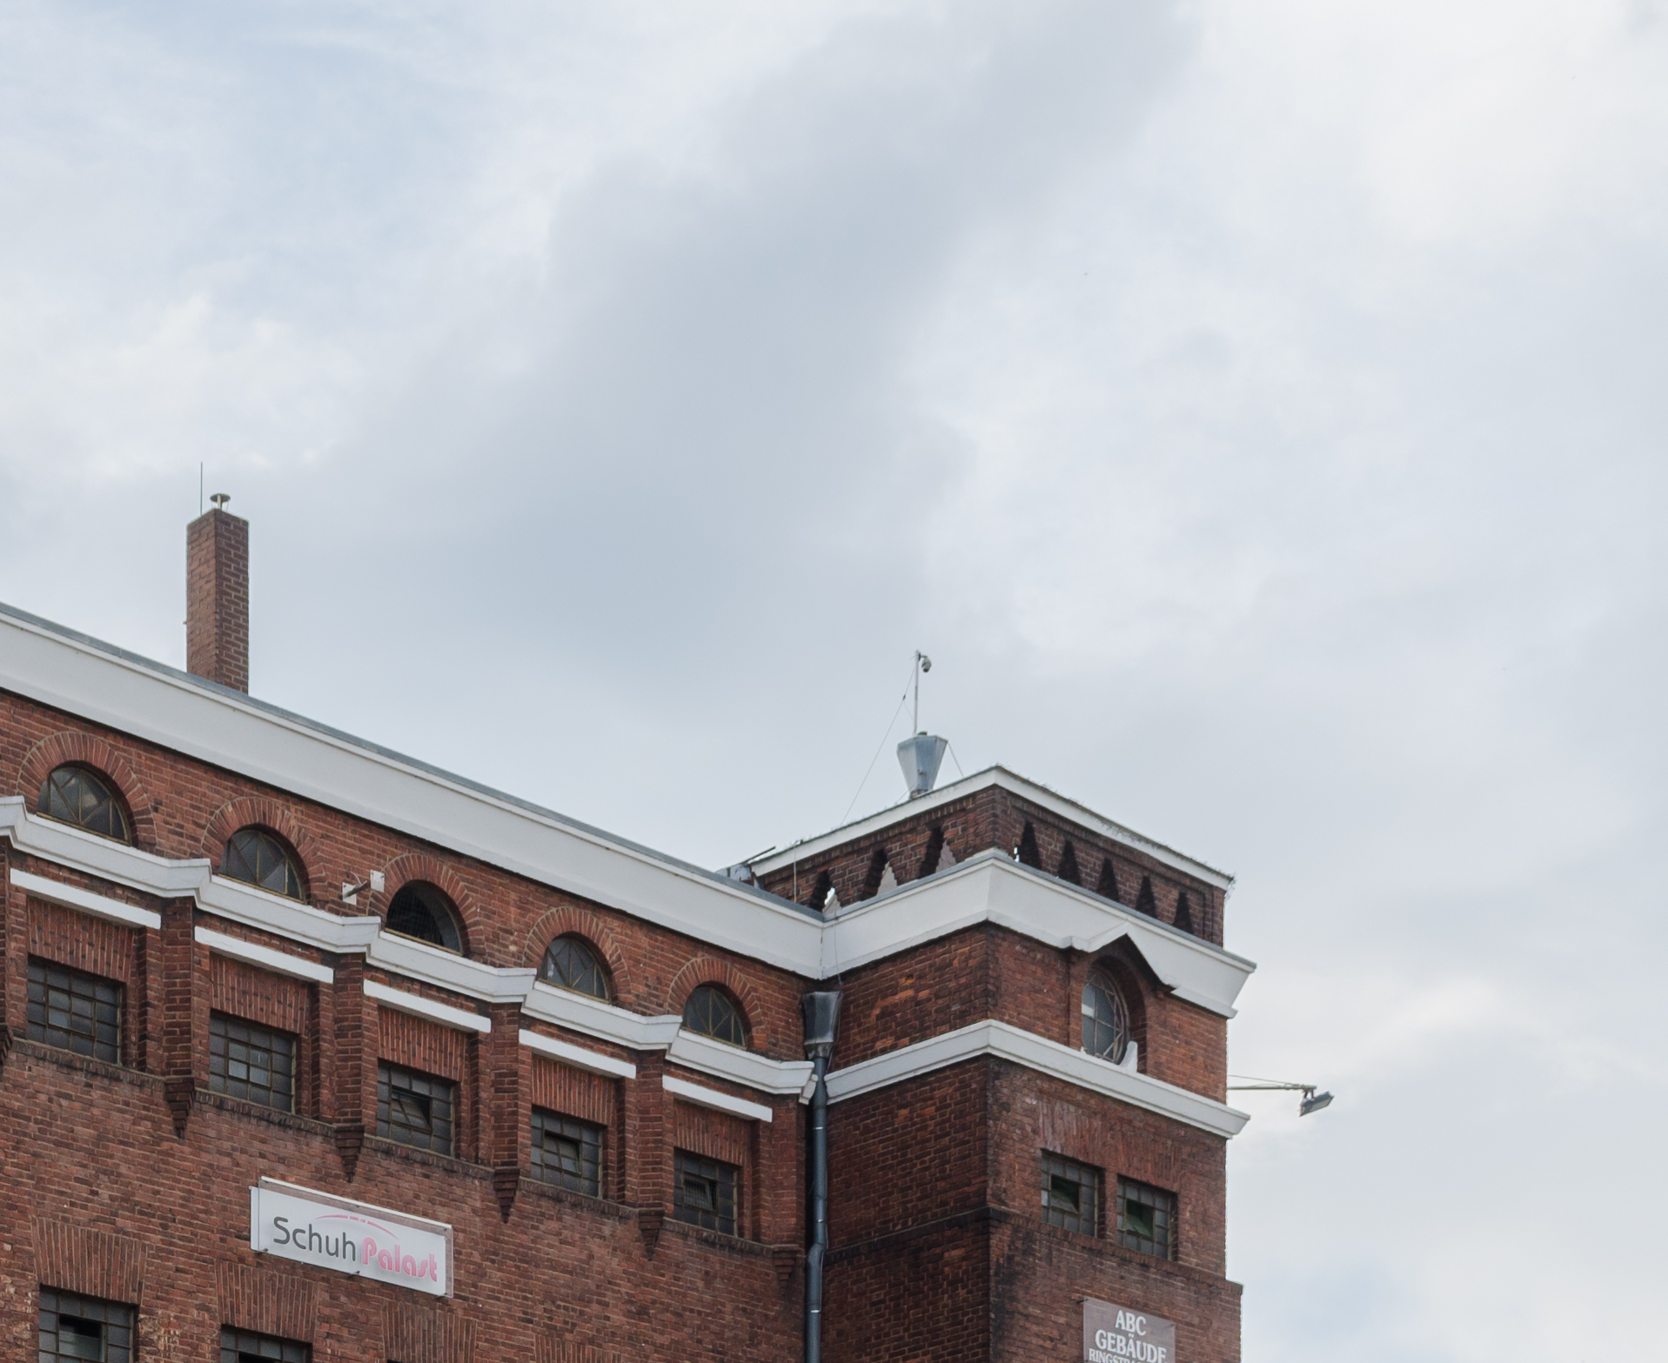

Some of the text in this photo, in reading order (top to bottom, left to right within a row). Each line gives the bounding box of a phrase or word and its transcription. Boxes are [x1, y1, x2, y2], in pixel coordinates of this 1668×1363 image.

[273, 1216, 438, 1282] Schuh Palast
[1115, 1310, 1146, 1336] ABC
